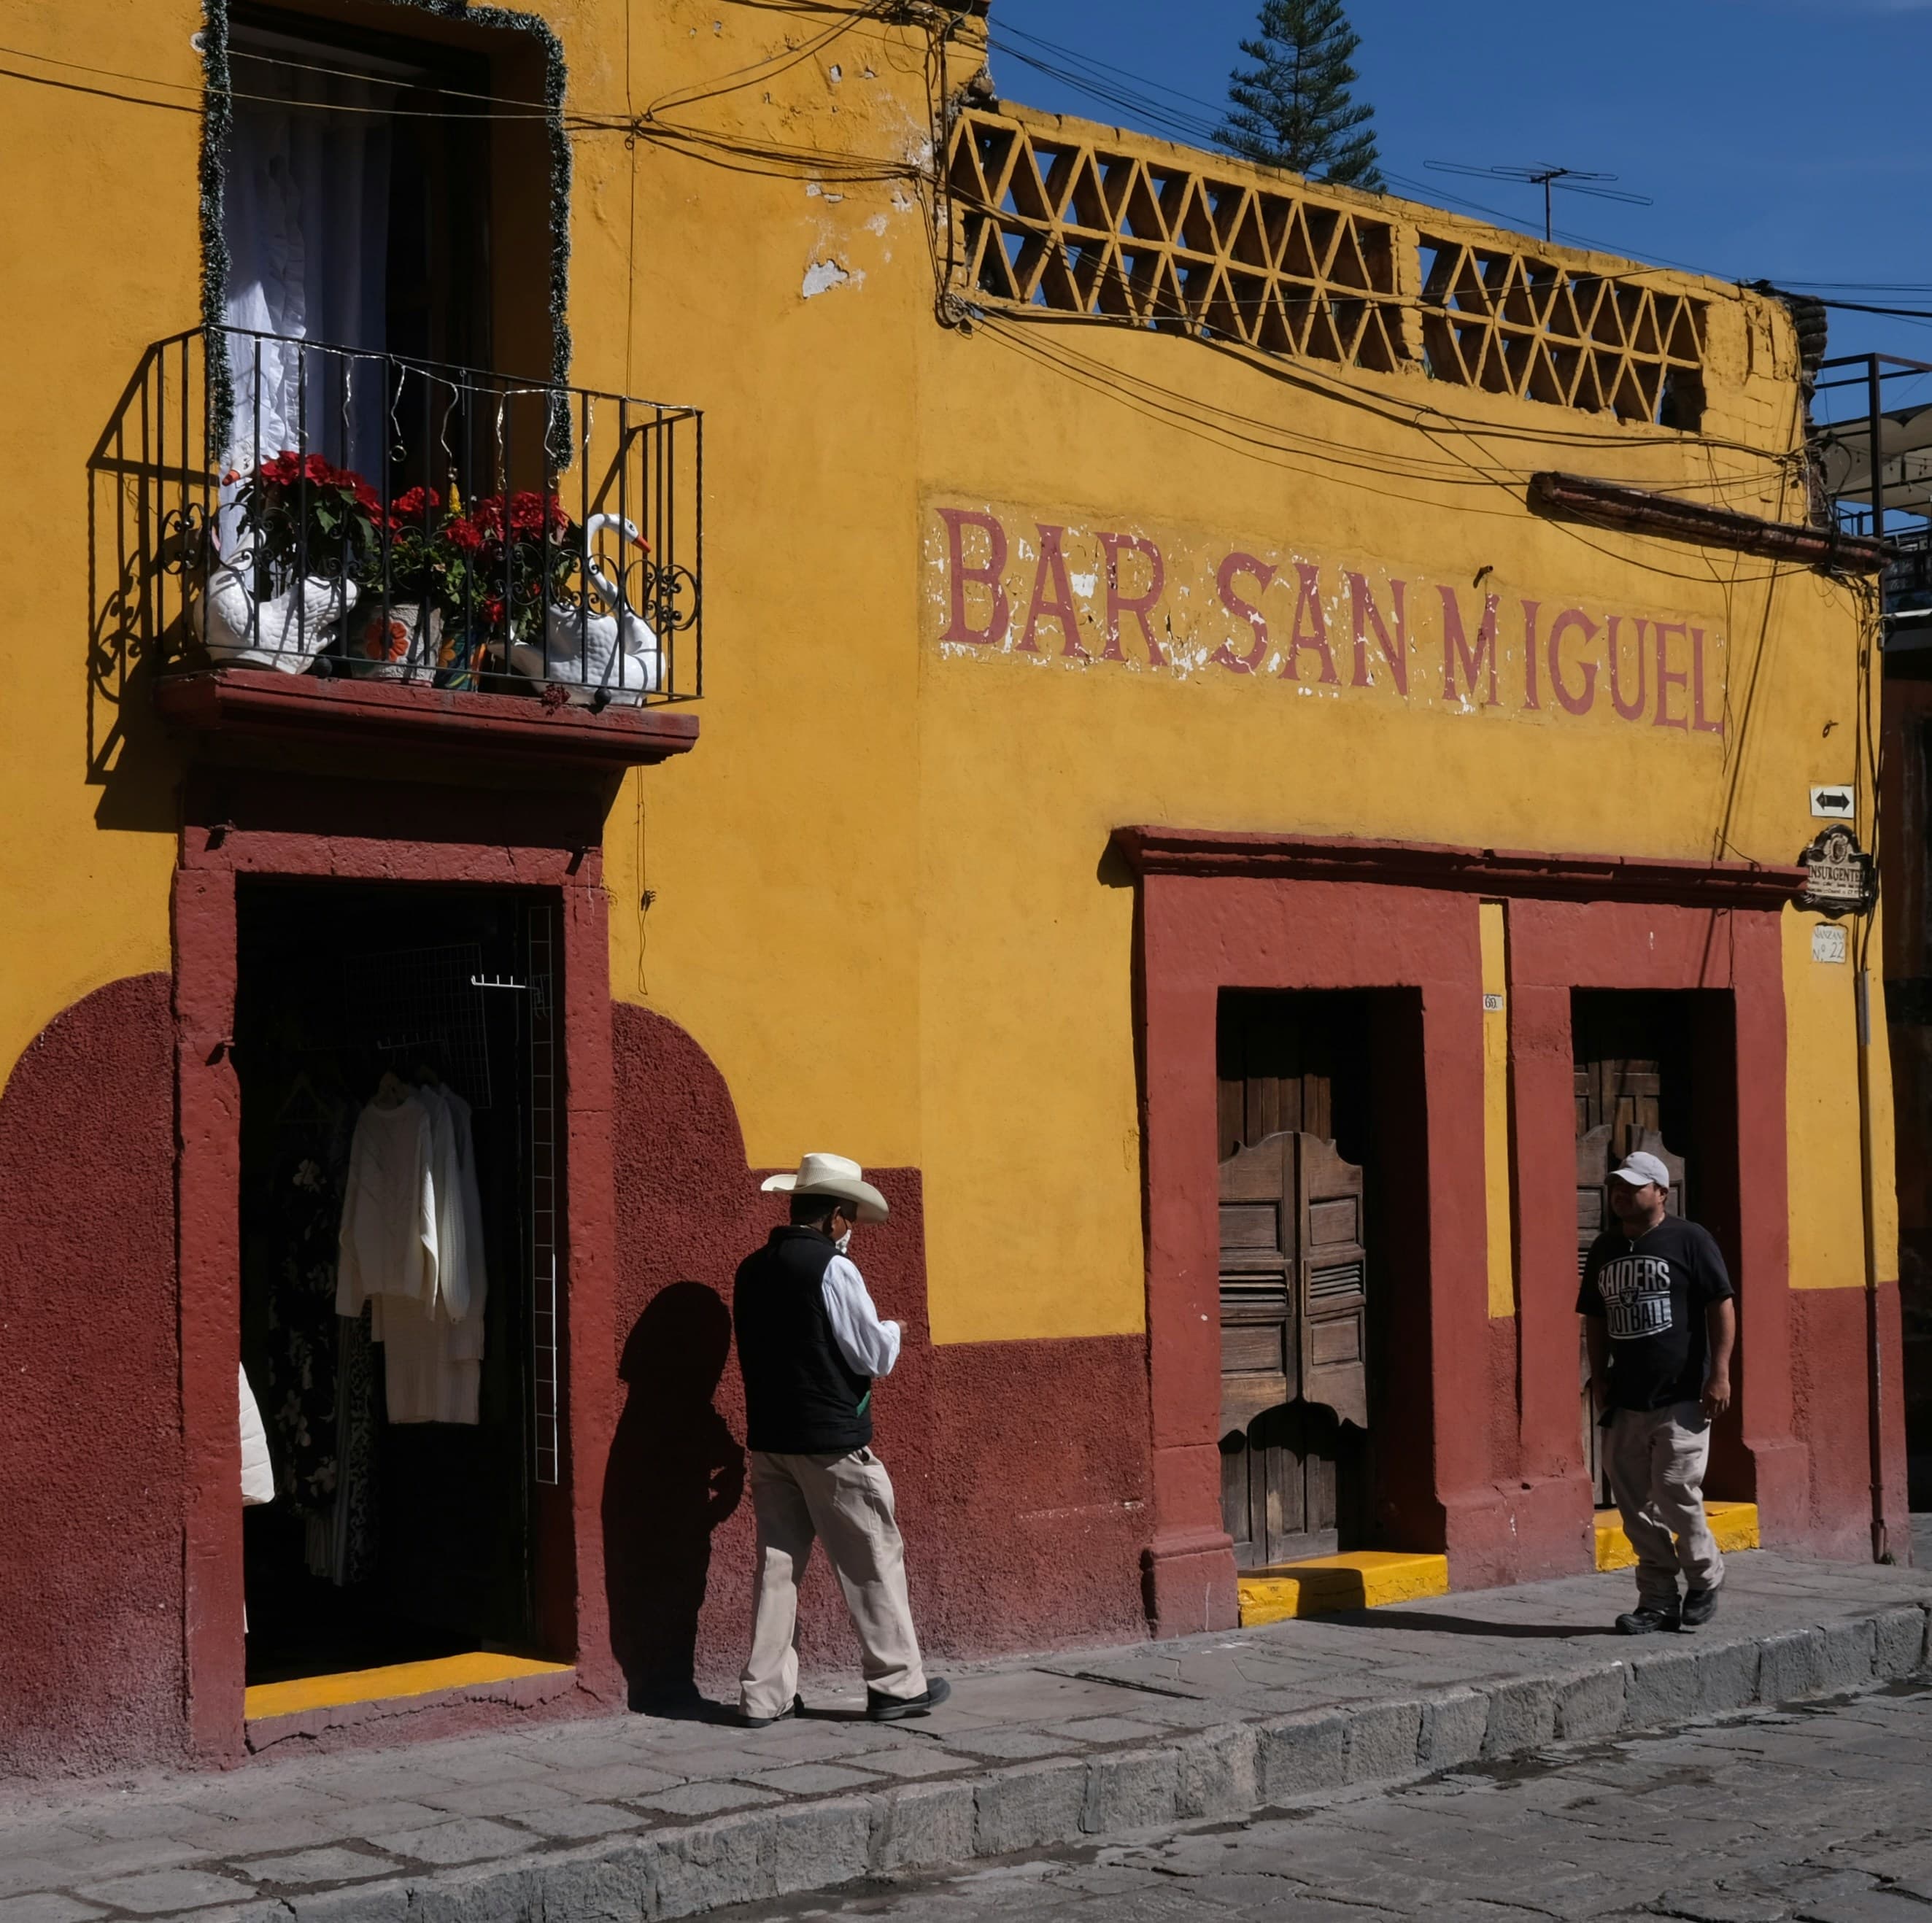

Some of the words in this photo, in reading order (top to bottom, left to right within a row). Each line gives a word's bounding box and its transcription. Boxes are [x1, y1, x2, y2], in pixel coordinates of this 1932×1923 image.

[935, 508, 1168, 667] BAR
[1208, 552, 1408, 697] SAN
[1436, 584, 1725, 736] MIGUEL
[1829, 942, 1845, 959] 22
[1598, 1259, 1671, 1297] RAIDERS
[1607, 1299, 1671, 1333] OOTBALL
